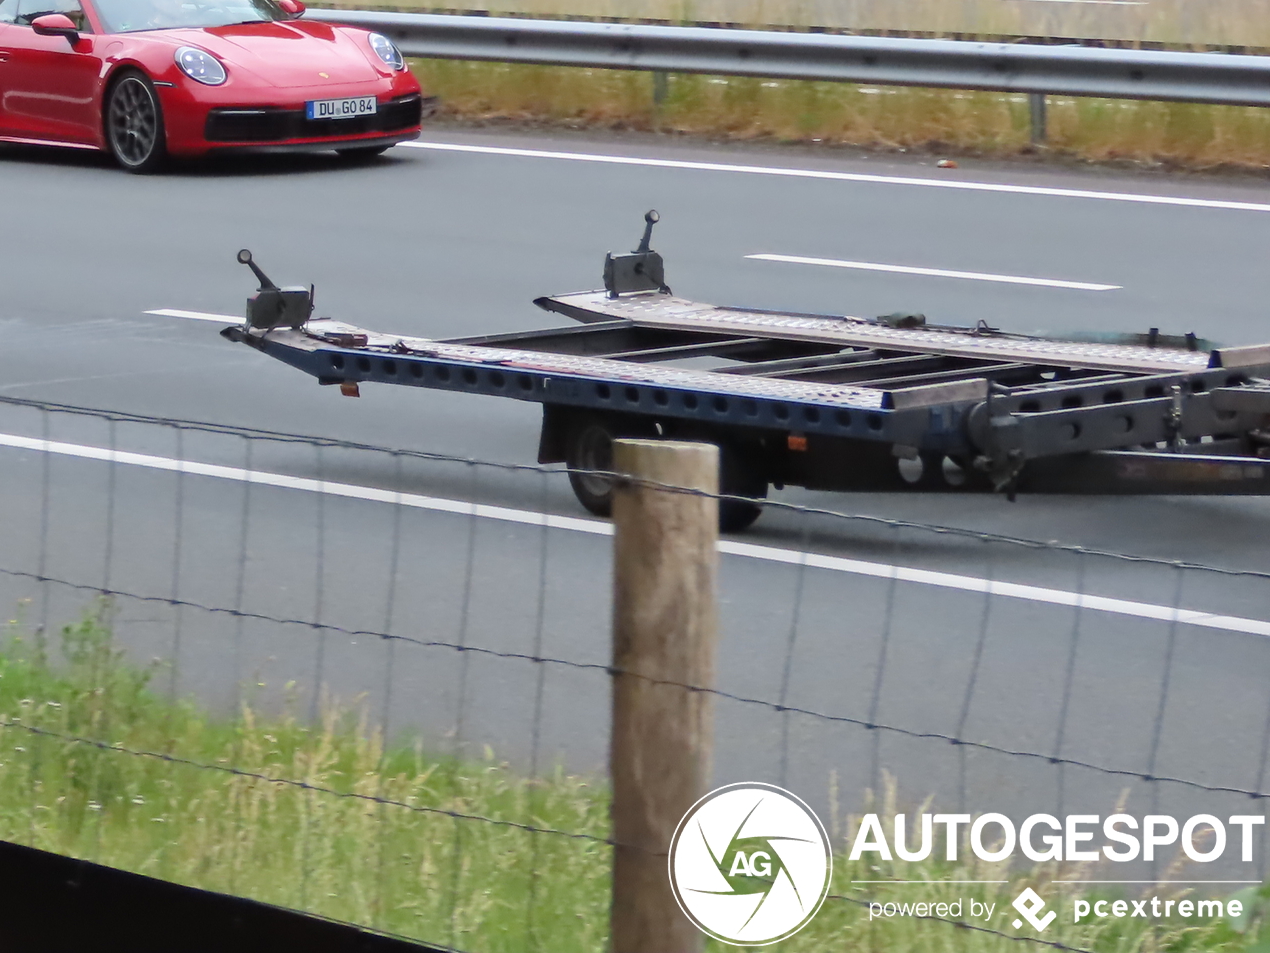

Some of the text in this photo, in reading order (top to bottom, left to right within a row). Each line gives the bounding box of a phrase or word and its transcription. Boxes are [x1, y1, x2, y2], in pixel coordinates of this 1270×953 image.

[319, 102, 334, 116] DU
[342, 100, 357, 114] GO
[359, 99, 372, 112] 84
